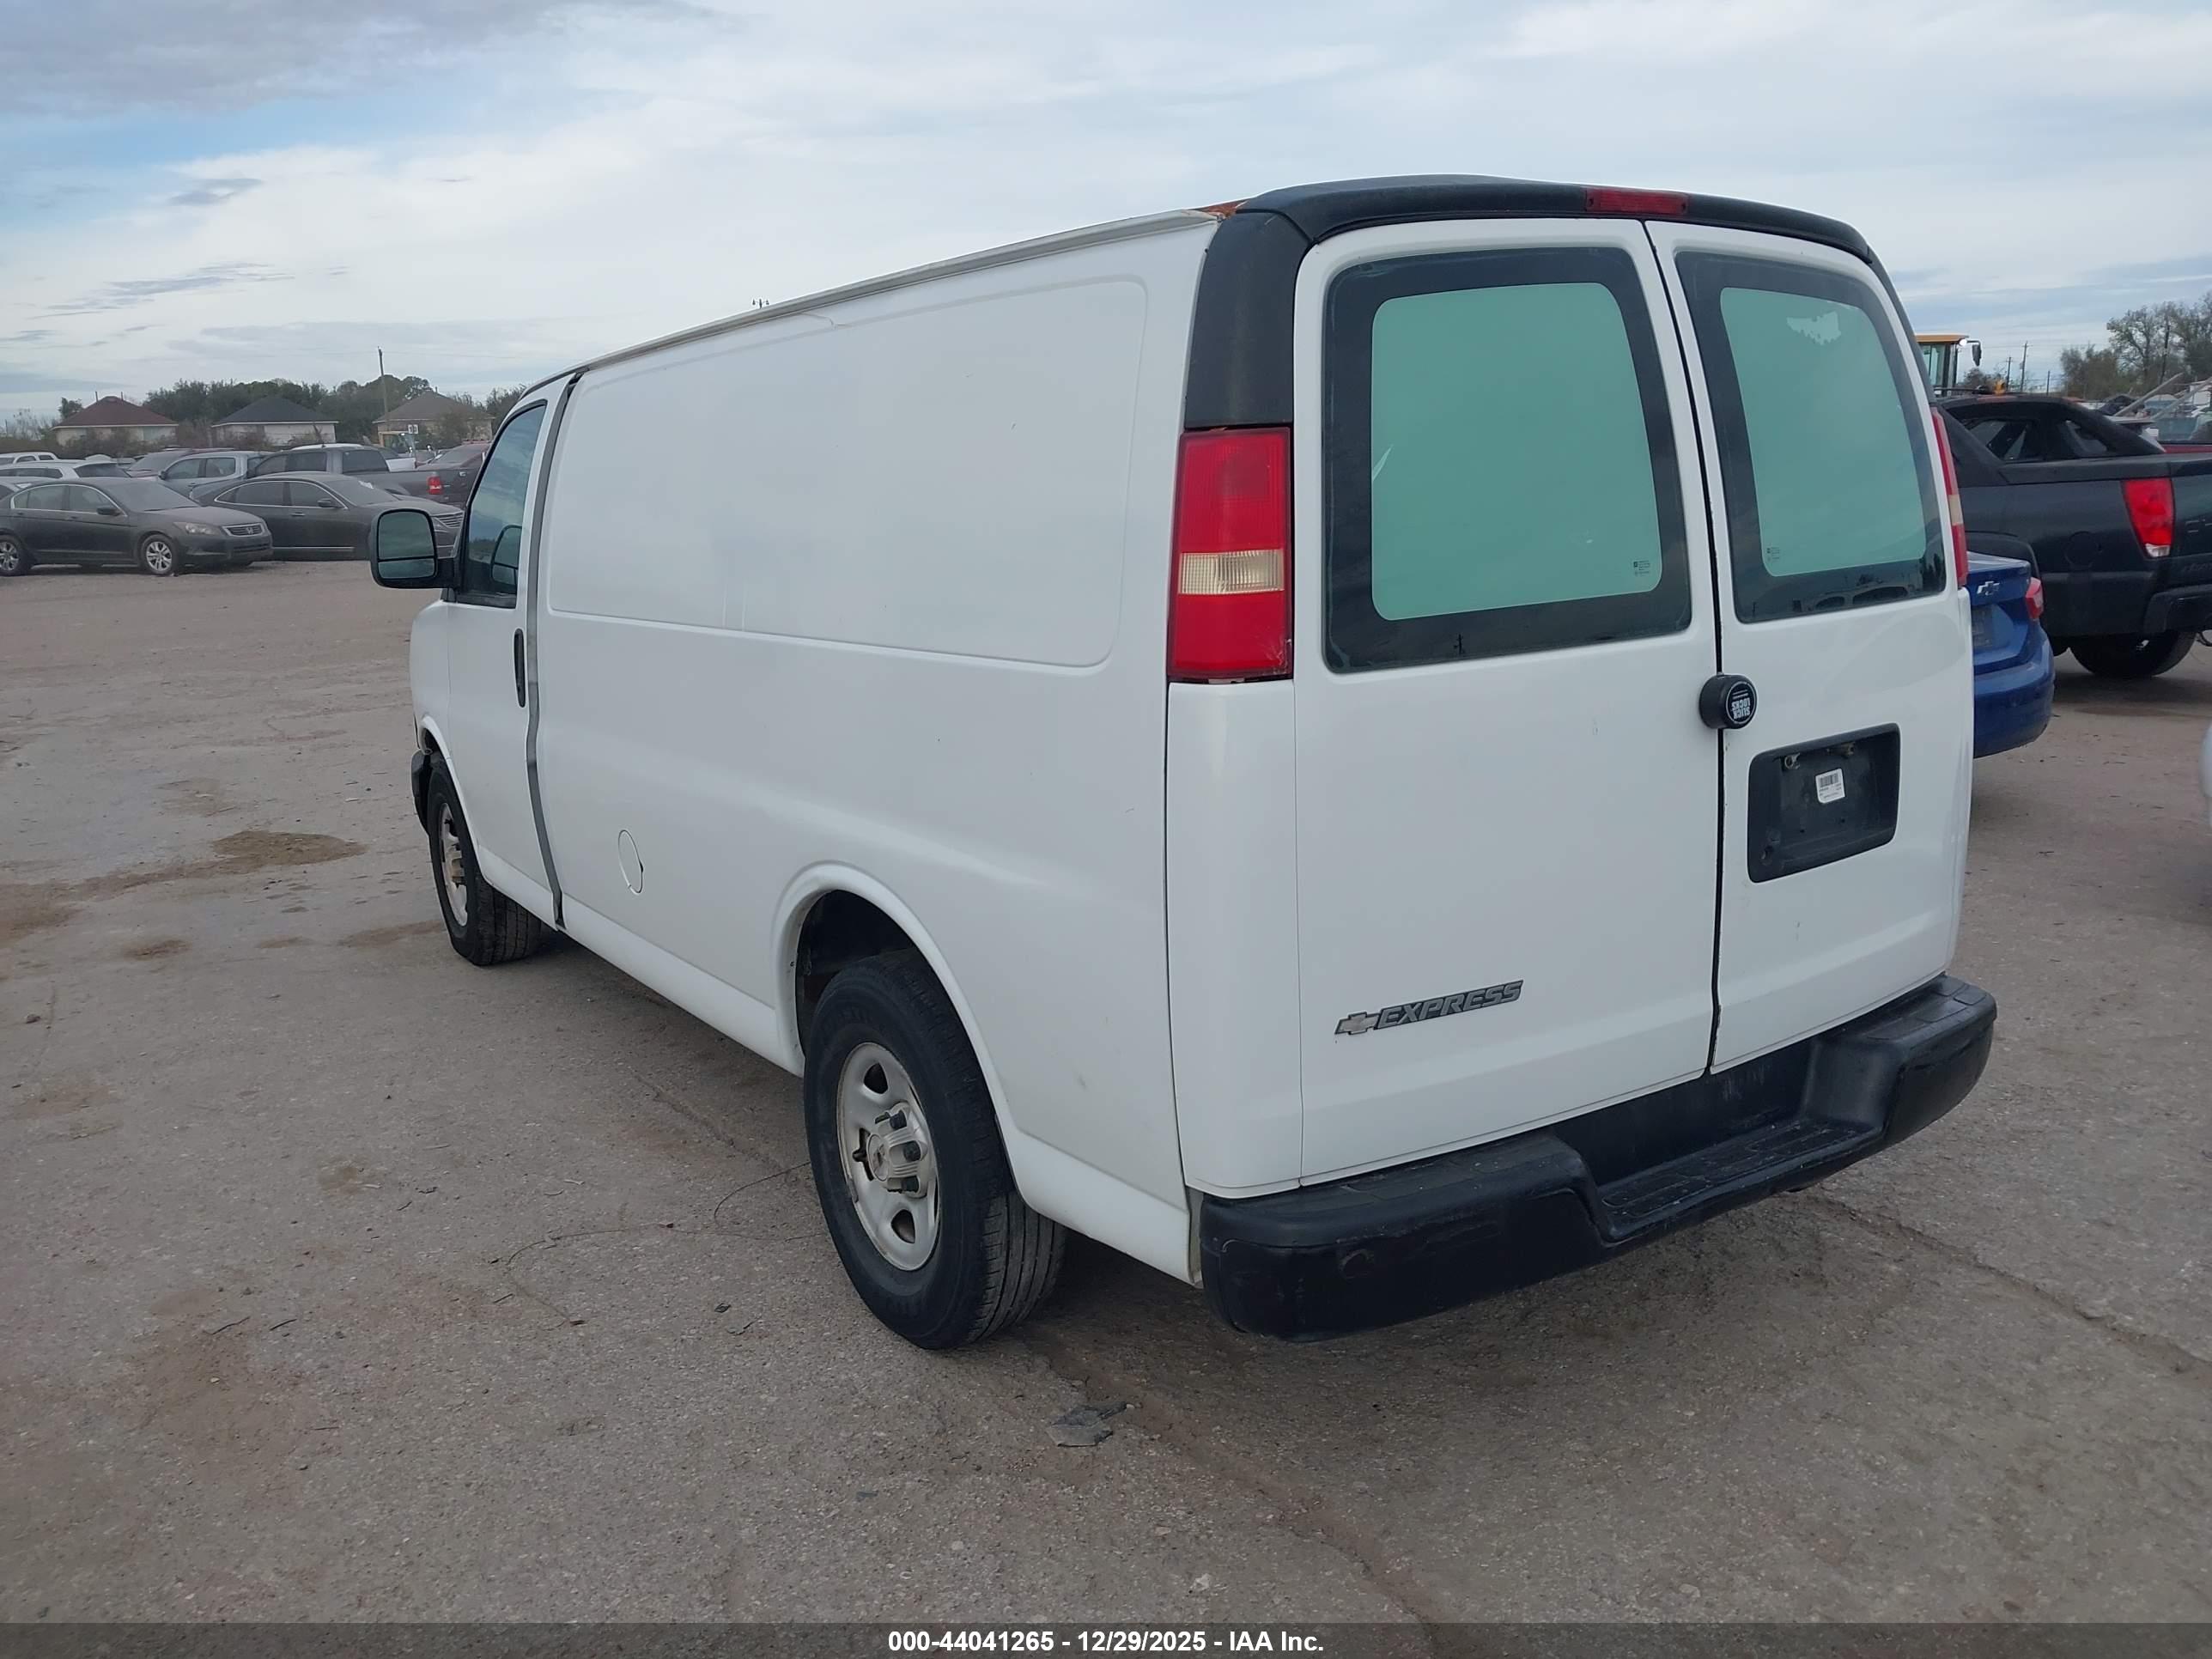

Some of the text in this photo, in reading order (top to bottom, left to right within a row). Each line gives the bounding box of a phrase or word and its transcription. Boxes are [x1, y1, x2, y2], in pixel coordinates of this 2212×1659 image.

[1731, 697, 1751, 711] LOCKS
[1733, 706, 1751, 720] SLICK
[1376, 980, 1524, 1030] EXPRESS
